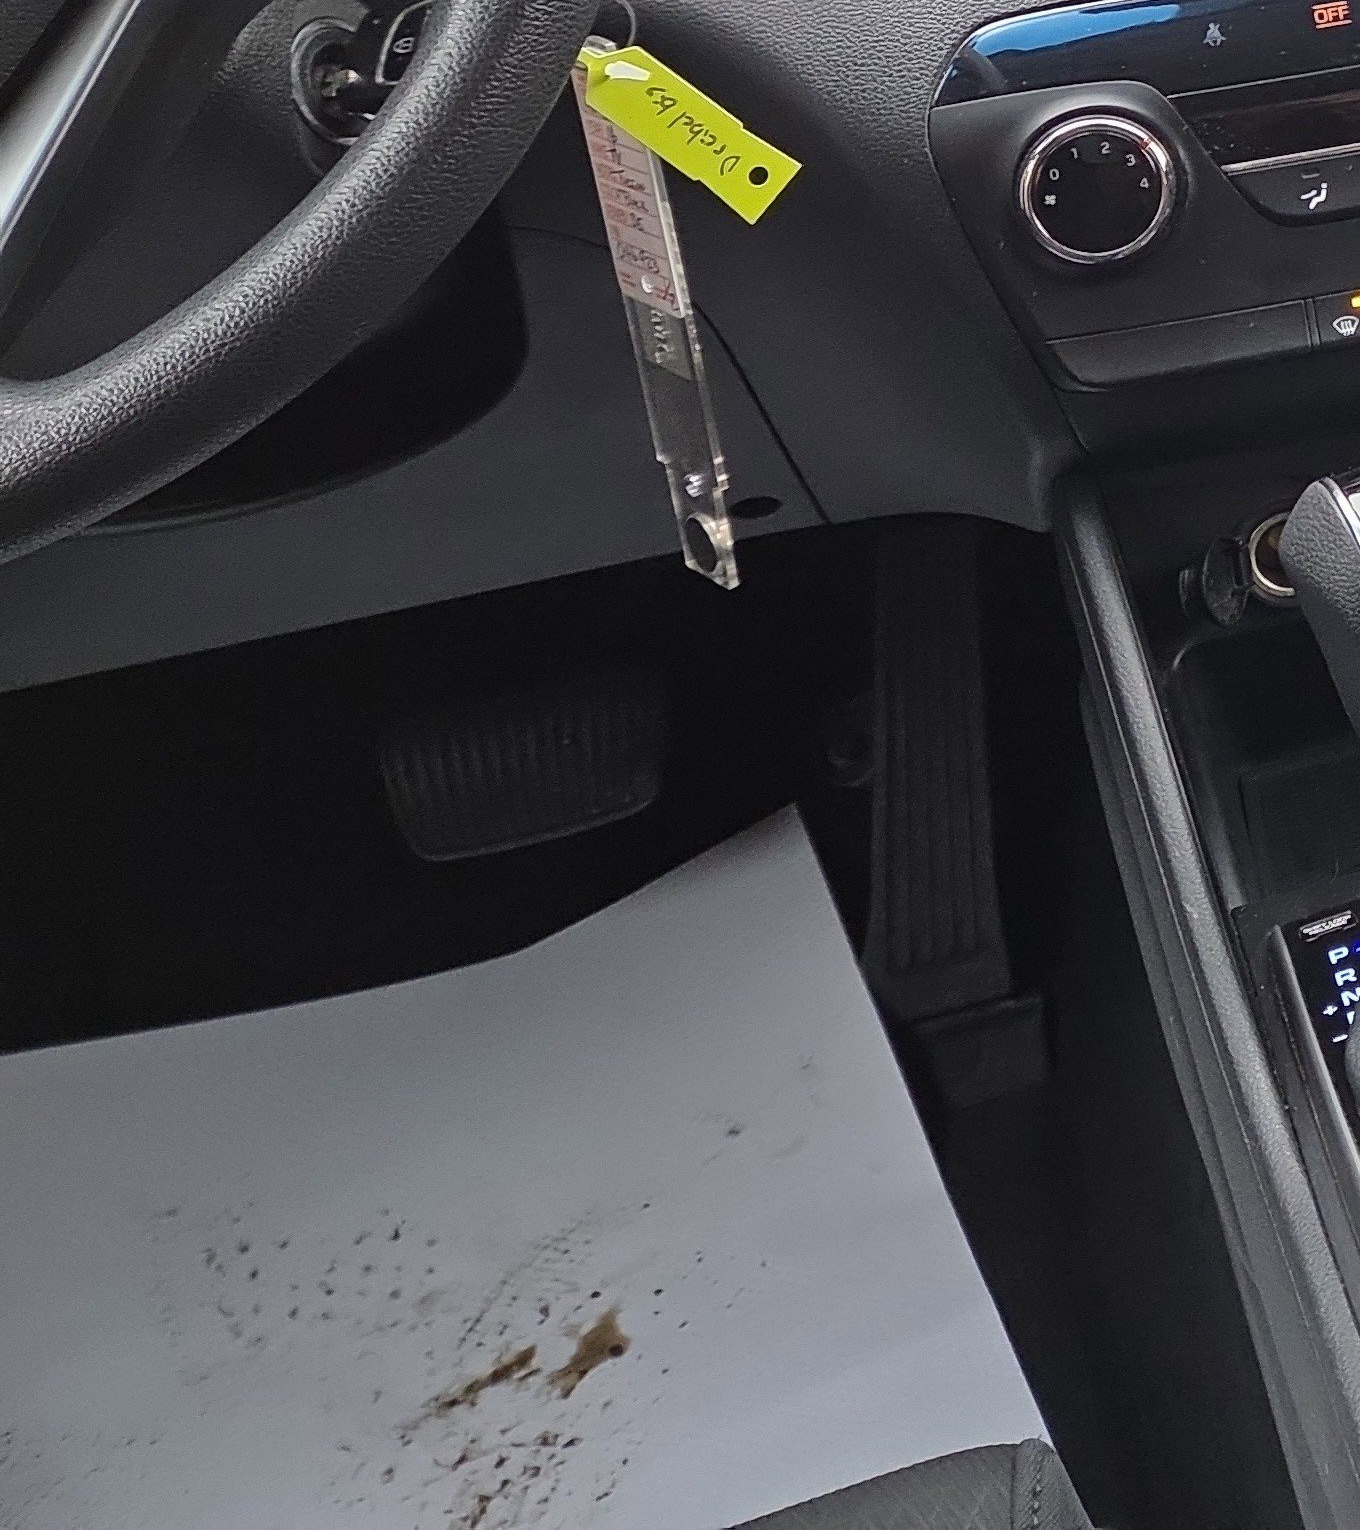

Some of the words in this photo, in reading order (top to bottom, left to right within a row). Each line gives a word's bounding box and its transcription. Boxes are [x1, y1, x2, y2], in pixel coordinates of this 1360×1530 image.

[1313, 4, 1350, 24] OFF
[1070, 147, 1079, 160] 1
[1100, 141, 1111, 155] 2
[1125, 154, 1137, 167] 3
[1049, 168, 1060, 181] 0
[1139, 177, 1150, 189] 4
[1328, 946, 1349, 965] P
[1334, 967, 1357, 987] R
